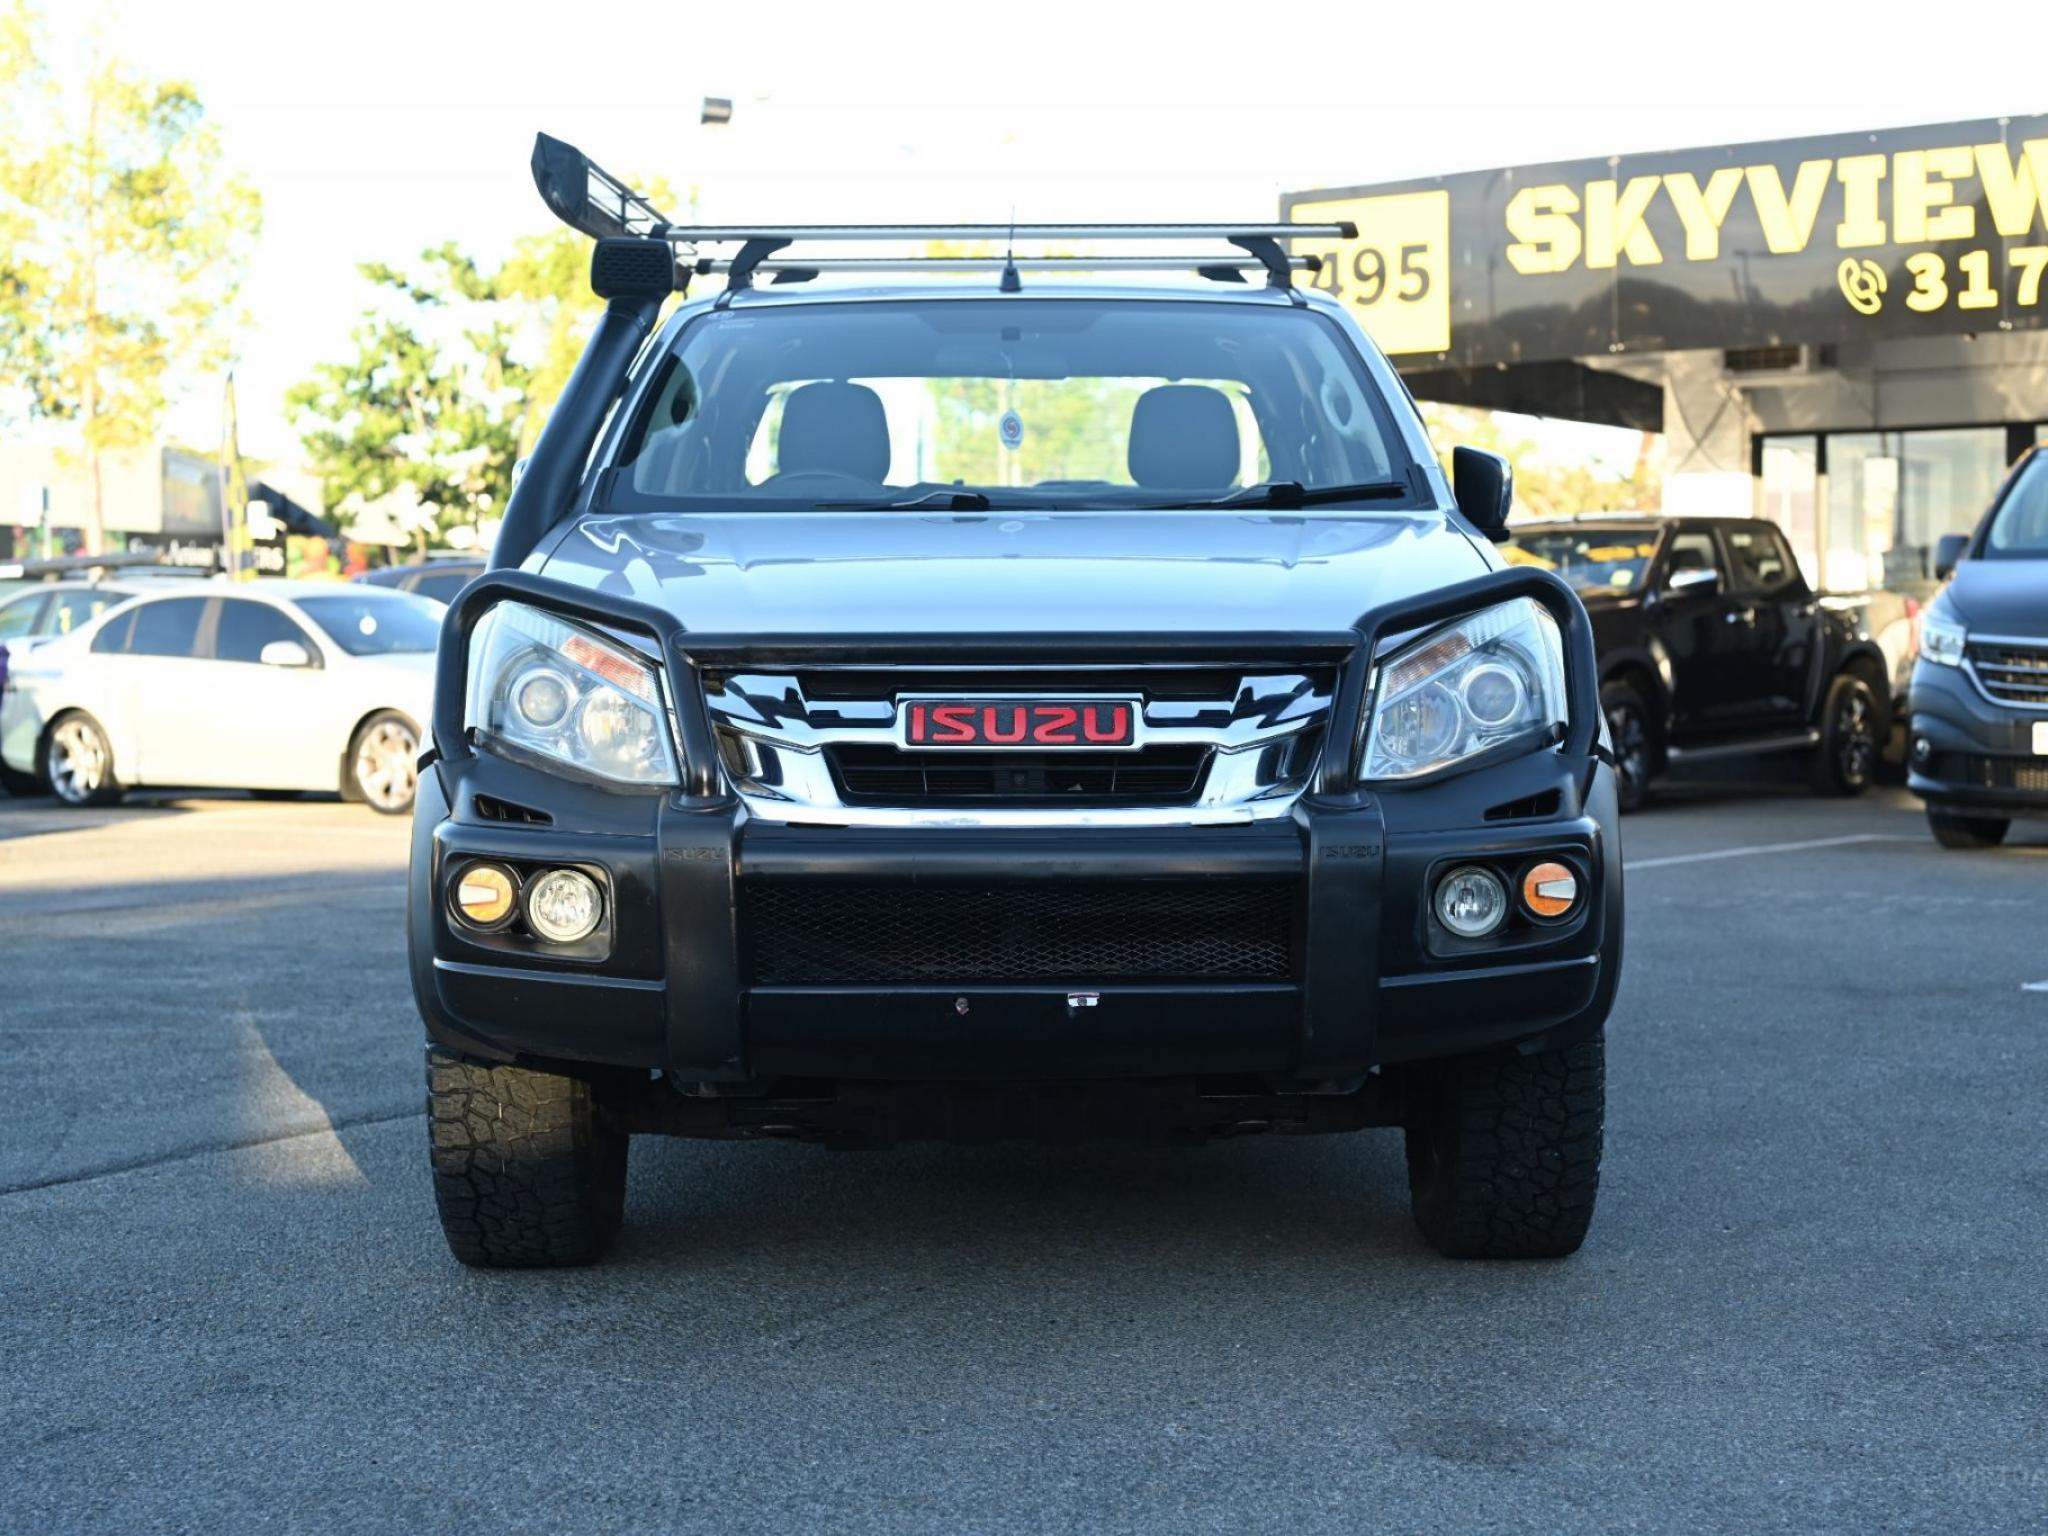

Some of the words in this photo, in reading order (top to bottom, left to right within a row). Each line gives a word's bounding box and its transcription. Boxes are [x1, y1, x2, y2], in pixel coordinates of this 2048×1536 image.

[1506, 138, 2048, 275] SKYVIEW
[1310, 244, 1430, 305] 495
[1905, 246, 2048, 312] 317
[912, 706, 1127, 742] ISUZU
[663, 847, 728, 861] ISUZU
[1320, 846, 1380, 858] ISUZU
